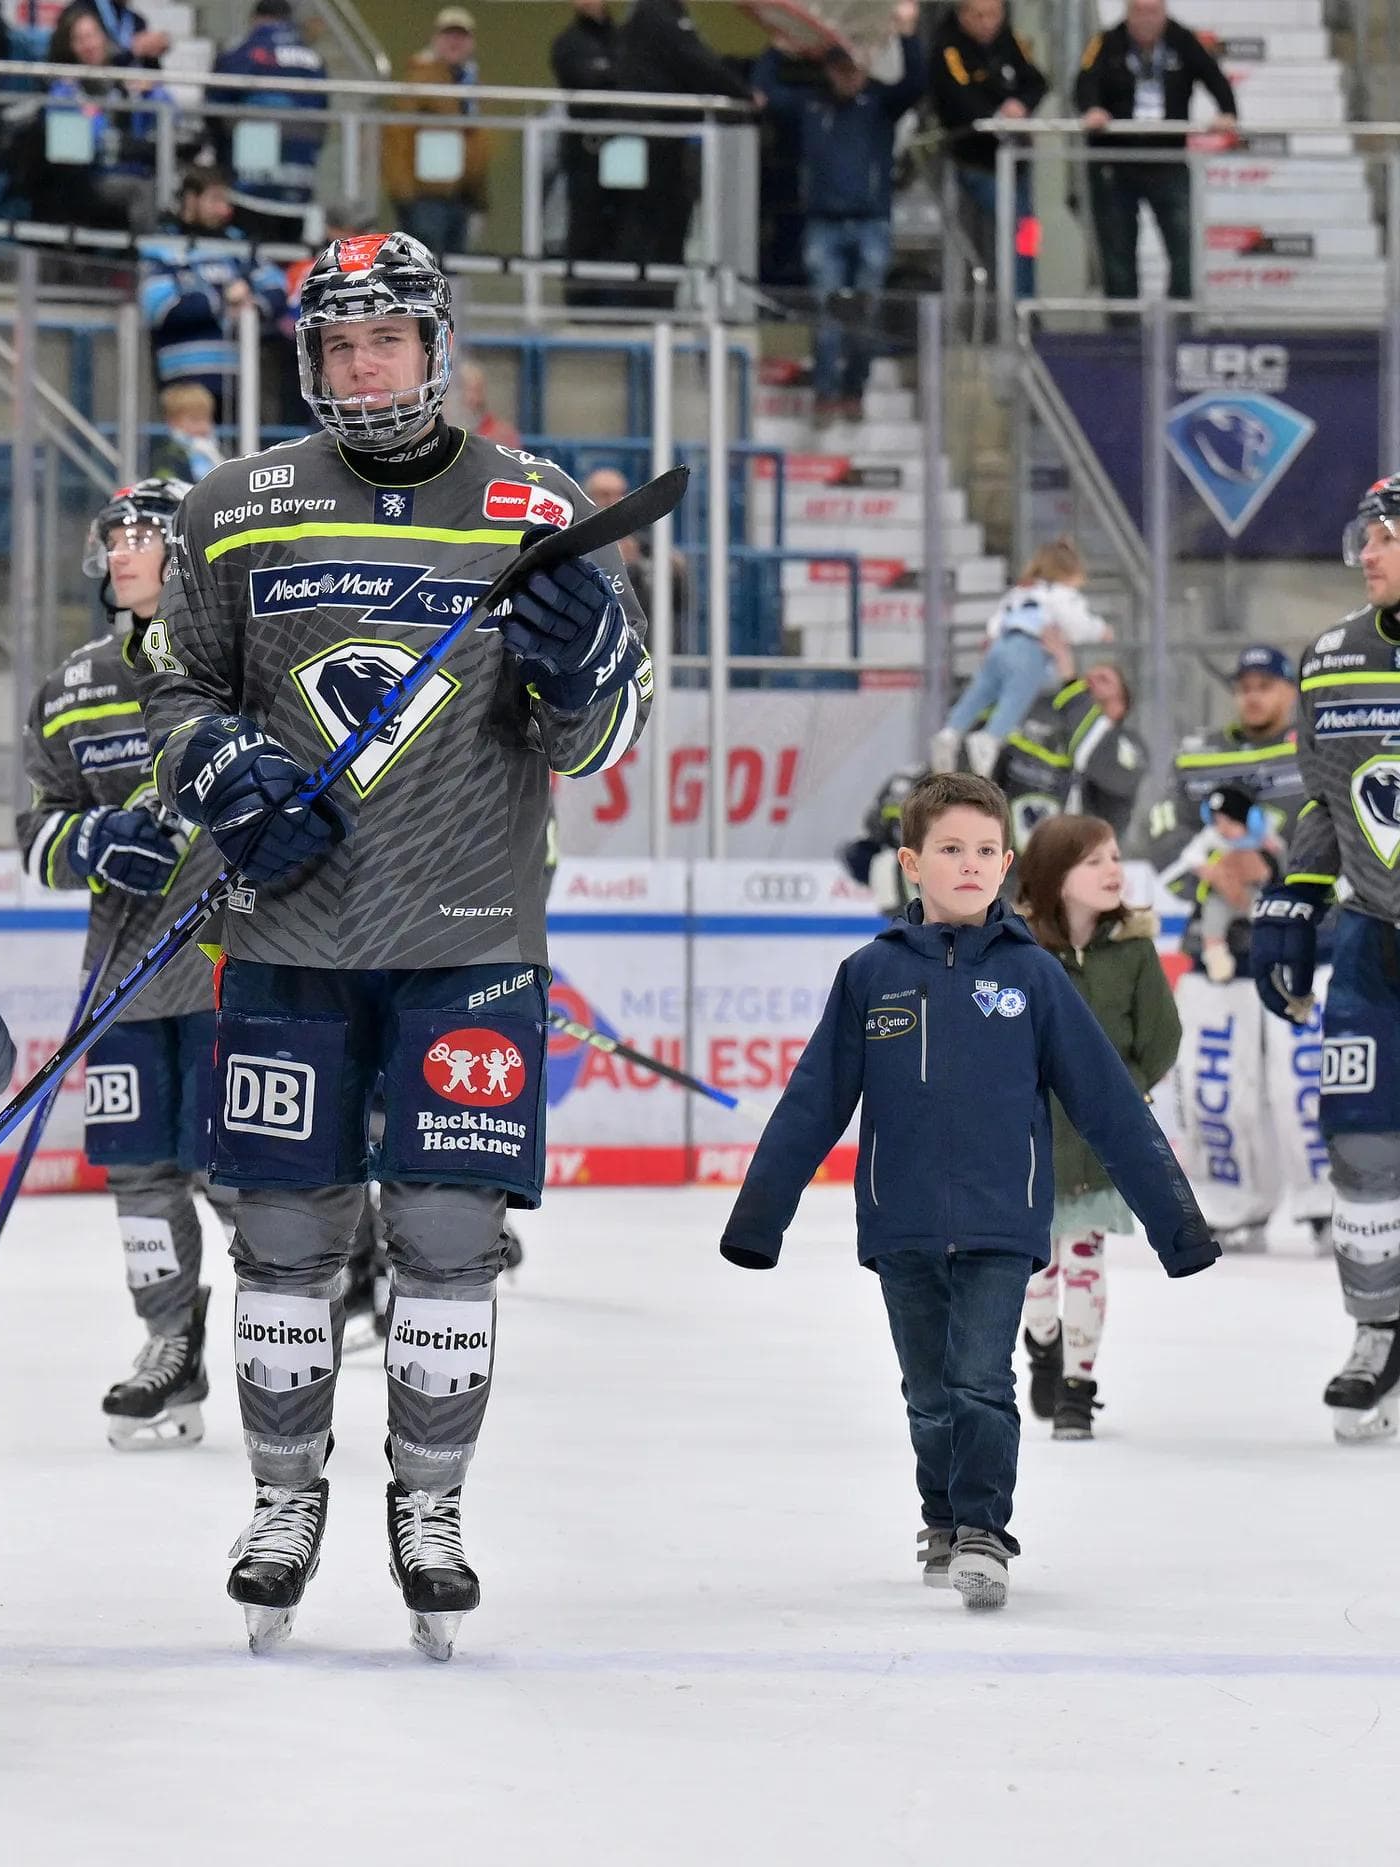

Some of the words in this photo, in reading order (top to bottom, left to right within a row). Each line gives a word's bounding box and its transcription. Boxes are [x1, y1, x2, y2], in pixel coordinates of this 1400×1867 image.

[255, 468, 289, 489] DB
[213, 501, 264, 528] Regio
[270, 497, 337, 517] Bayern
[452, 906, 513, 918] BAUER
[467, 969, 536, 1011] BAUER
[622, 985, 828, 1023] METZGER
[1321, 1044, 1366, 1085] DB
[86, 1071, 131, 1115] DB
[229, 1066, 300, 1127] DB
[416, 1110, 527, 1140] Backhaus
[422, 1131, 522, 1158] Hackner
[259, 1438, 318, 1456] BAUER
[403, 1441, 463, 1461] BAUER
